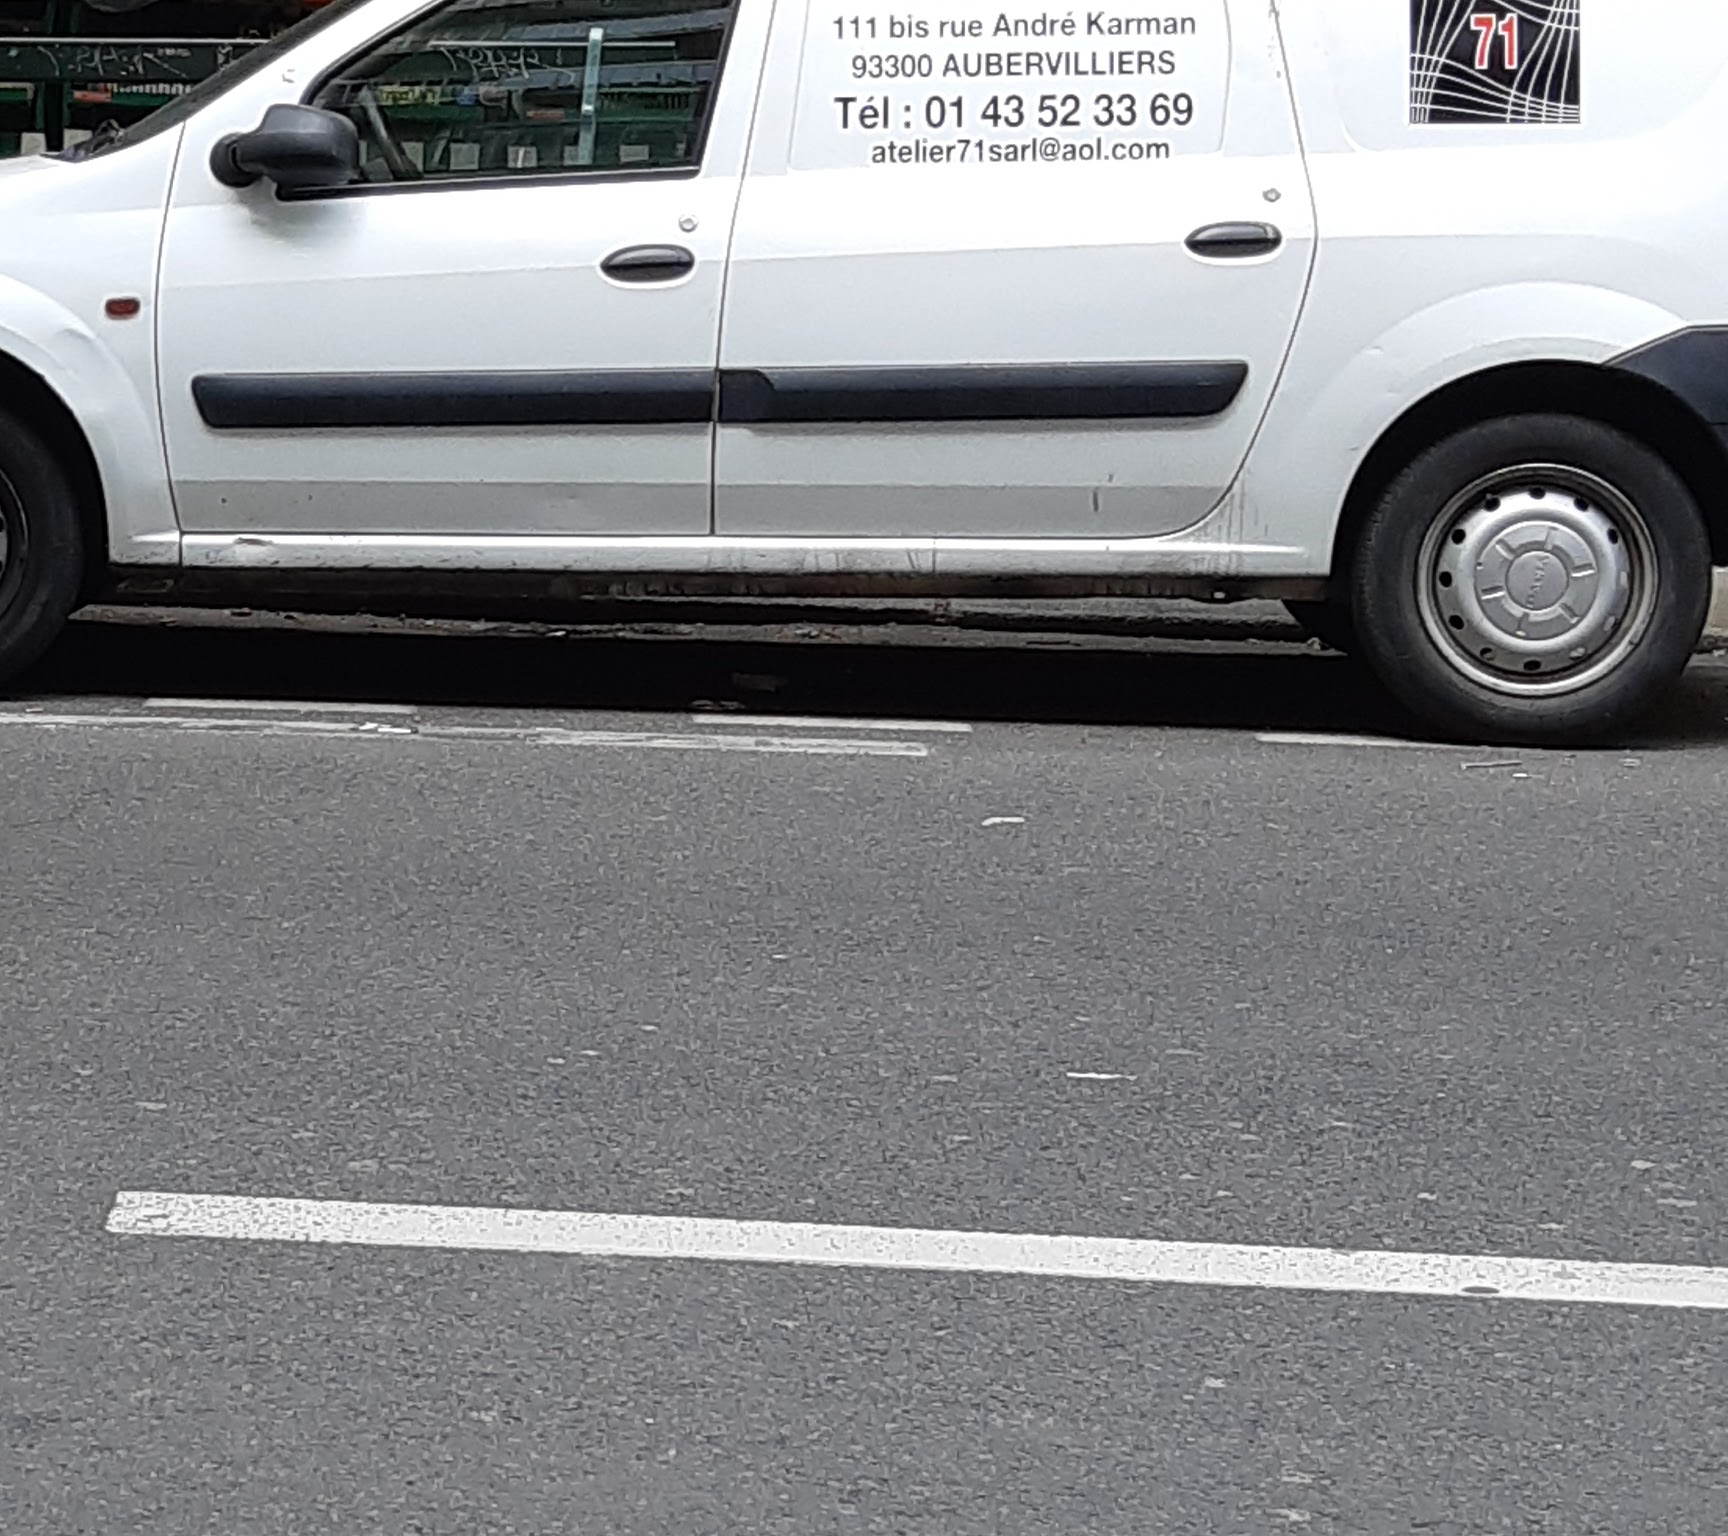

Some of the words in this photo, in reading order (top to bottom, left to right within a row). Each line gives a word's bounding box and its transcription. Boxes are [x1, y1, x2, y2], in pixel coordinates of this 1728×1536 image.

[833, 17, 877, 39] 111
[889, 14, 929, 39] bis
[939, 19, 983, 38] rue
[992, 11, 1076, 38] André
[1087, 12, 1196, 37] Karman
[1470, 14, 1518, 70] 71
[852, 55, 933, 79] 93300
[942, 51, 1176, 78] AUBERVILLIERS
[834, 96, 890, 130] Tél
[925, 96, 964, 129] 01
[981, 95, 1025, 128] 43
[1037, 94, 1081, 127] 52
[1093, 93, 1137, 127] 33
[1150, 92, 1194, 126] 69
[872, 138, 1170, 164] atelier71sarl@aol.com
